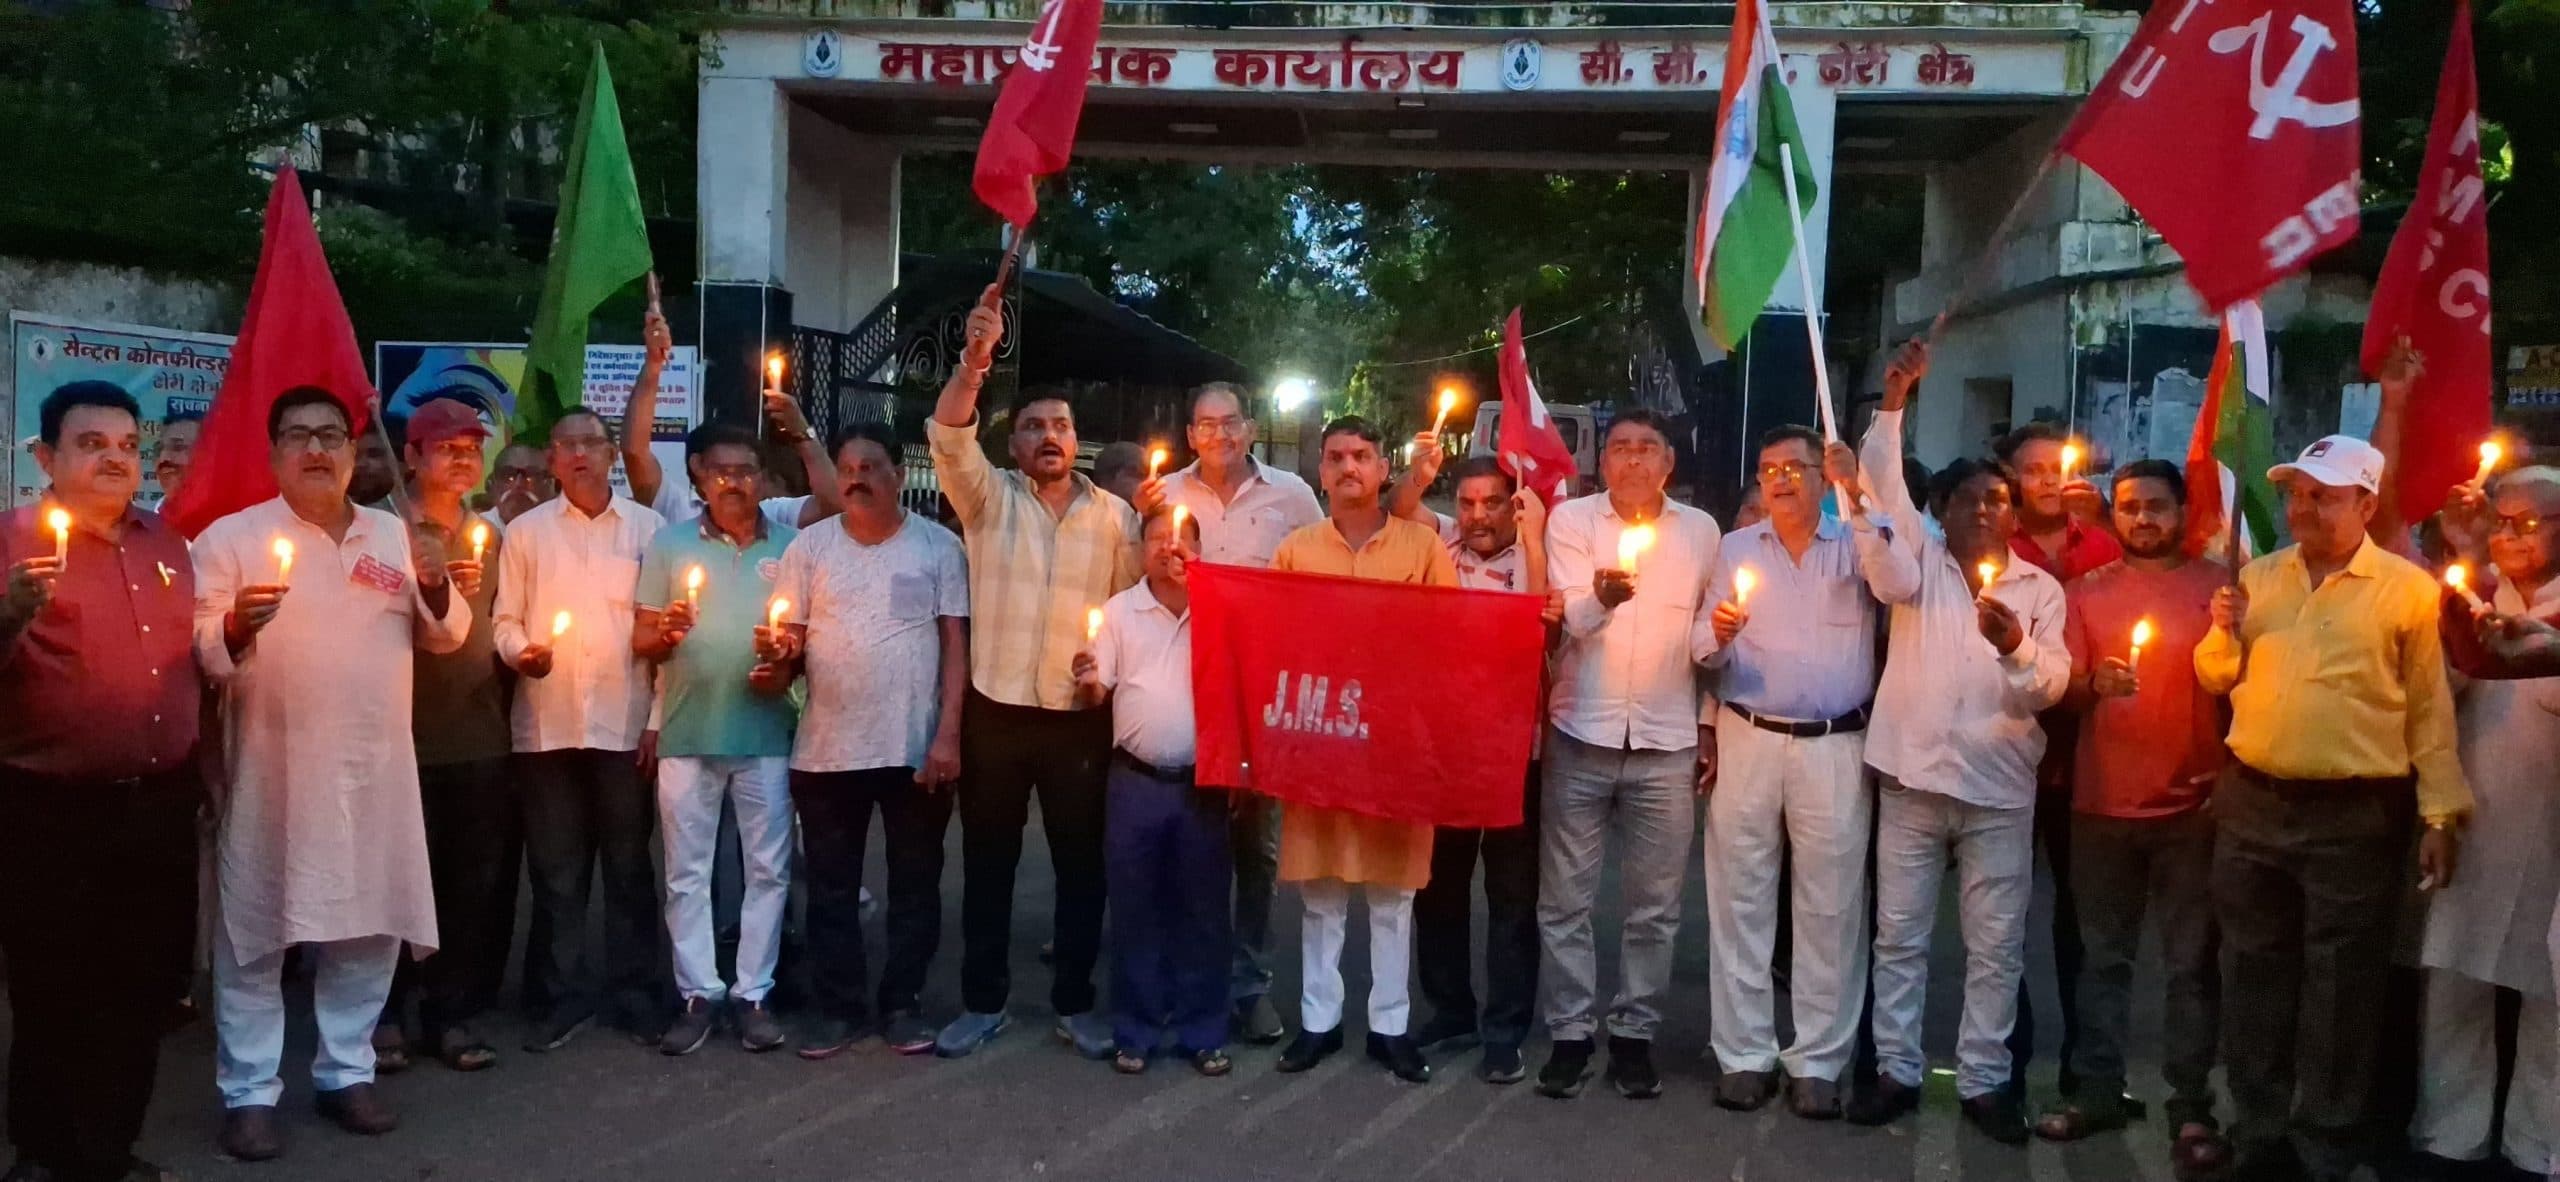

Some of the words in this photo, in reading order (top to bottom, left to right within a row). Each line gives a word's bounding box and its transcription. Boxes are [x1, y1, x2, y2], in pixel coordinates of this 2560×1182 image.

[1213, 35, 1465, 88] कार्यालय
[1579, 41, 1633, 84] सी.
[1653, 41, 1707, 84] सी.
[1817, 41, 1890, 84] ढोरी
[1917, 42, 1975, 85] क्षेत्र
[62, 333, 121, 363] सेन्ट्रल
[1263, 669, 1370, 740] J.M.S.
